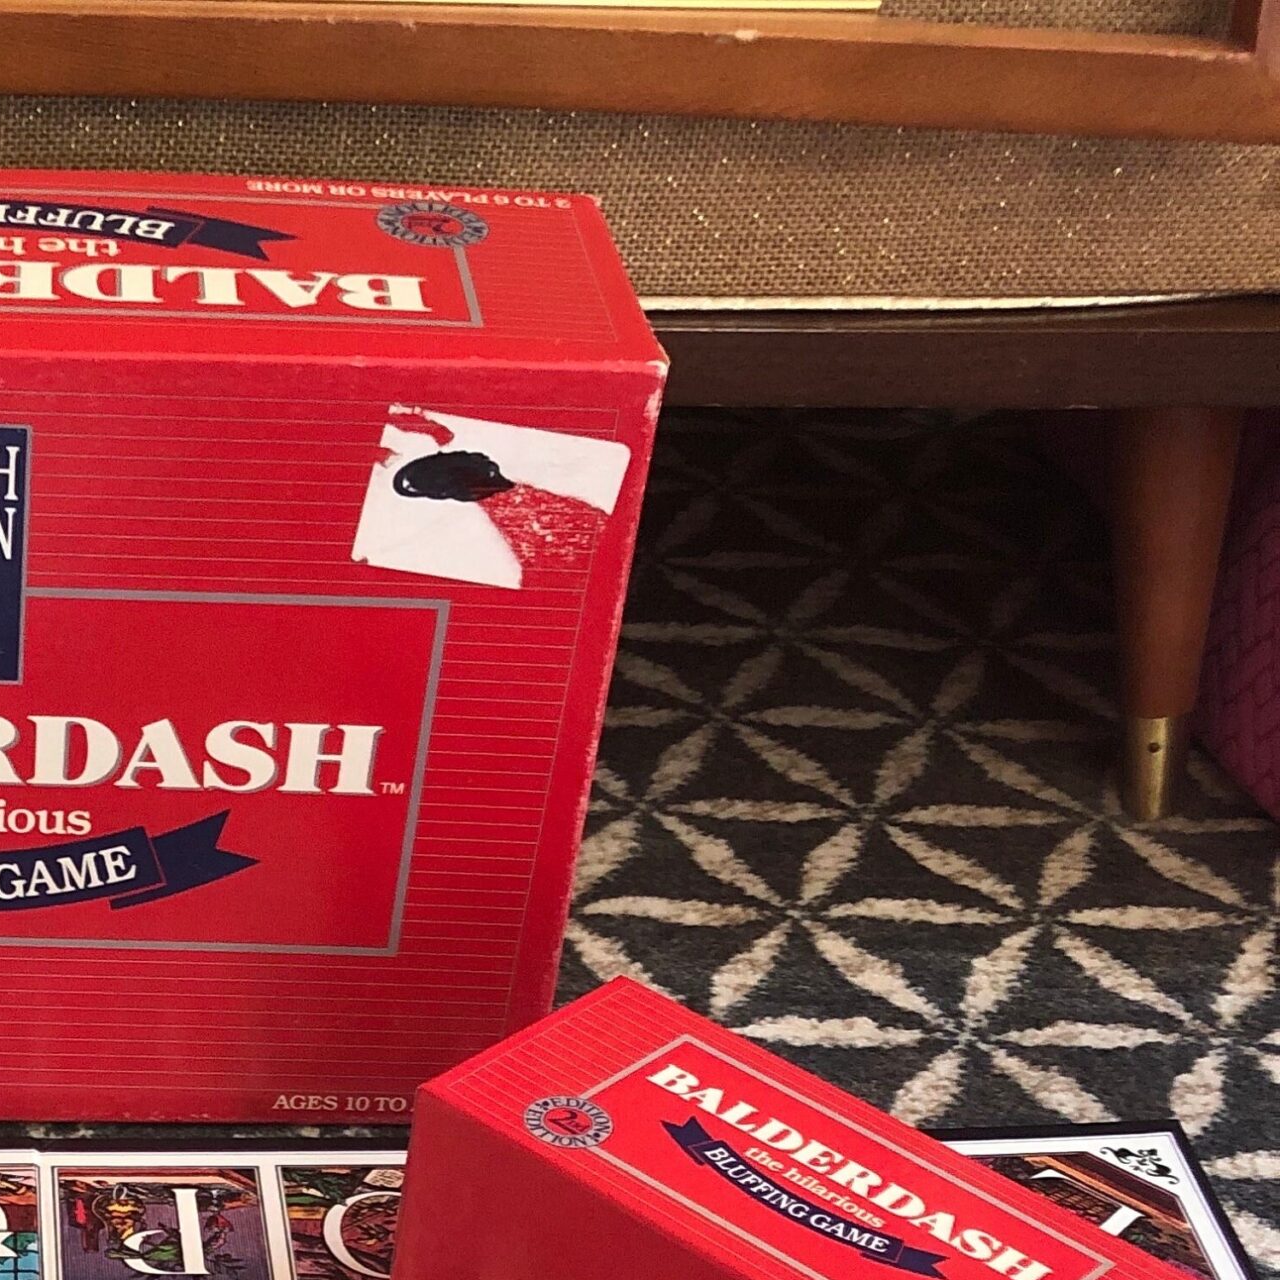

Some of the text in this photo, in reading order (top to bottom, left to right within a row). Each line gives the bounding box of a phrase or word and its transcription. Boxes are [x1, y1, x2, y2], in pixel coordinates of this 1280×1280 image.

[246, 180, 323, 194] MORE
[329, 184, 366, 196] OR
[371, 186, 488, 205] PLAYERS
[515, 195, 551, 208] TO
[556, 197, 572, 208] 2
[38, 236, 120, 257] the
[272, 1094, 407, 1112] AGES 10 TO
[744, 1145, 885, 1228] the hilarious
[704, 1147, 890, 1254] BLUFFING GAME
